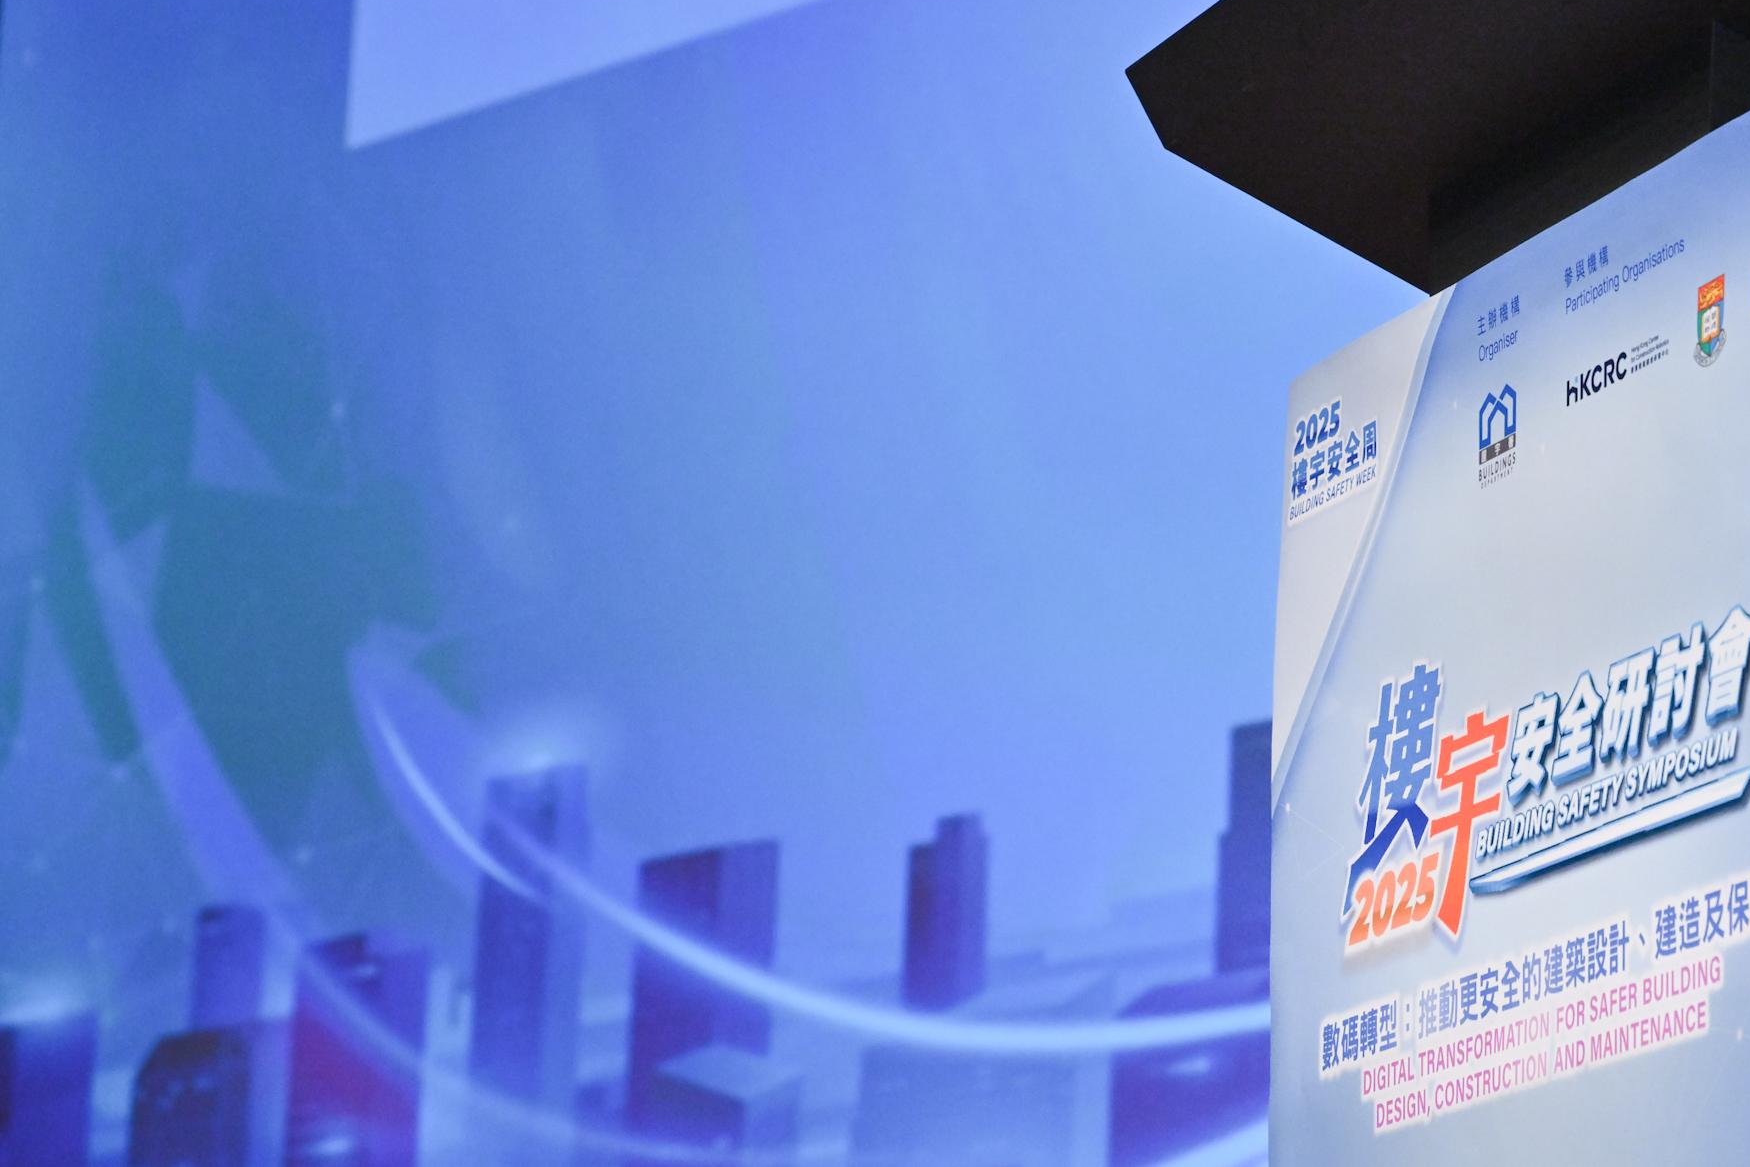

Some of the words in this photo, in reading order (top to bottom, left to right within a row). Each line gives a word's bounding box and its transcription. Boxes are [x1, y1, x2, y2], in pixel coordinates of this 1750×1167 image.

[1565, 274, 1620, 314] Participating
[1622, 239, 1685, 283] Organisations
[1478, 330, 1519, 362] Organiser
[1291, 420, 1377, 501] 樓宇安全周
[1294, 400, 1341, 456] 2025
[1478, 452, 1516, 482] BUILDINGS
[1289, 493, 1324, 521] BUILDING
[1326, 474, 1354, 502] SAFETY
[1356, 464, 1376, 486] WEEK
[1476, 805, 1554, 861] BUILDING
[1556, 776, 1625, 829] SAFETY
[1624, 728, 1739, 802] SYMPOSIUM
[1349, 853, 1439, 946] 2025
[1363, 1057, 1414, 1095] DIGITAL
[1418, 1012, 1549, 1077] TRANSFORMATION
[1556, 1000, 1585, 1033] FOR
[1590, 982, 1638, 1022] SAFER
[1643, 956, 1721, 1005] BUILDING
[1376, 1089, 1430, 1128] DESIGN,
[1435, 1051, 1547, 1109] CONSTRUCTION
[1554, 1040, 1586, 1073] AND
[1590, 1001, 1707, 1062] MAINTENANCE
